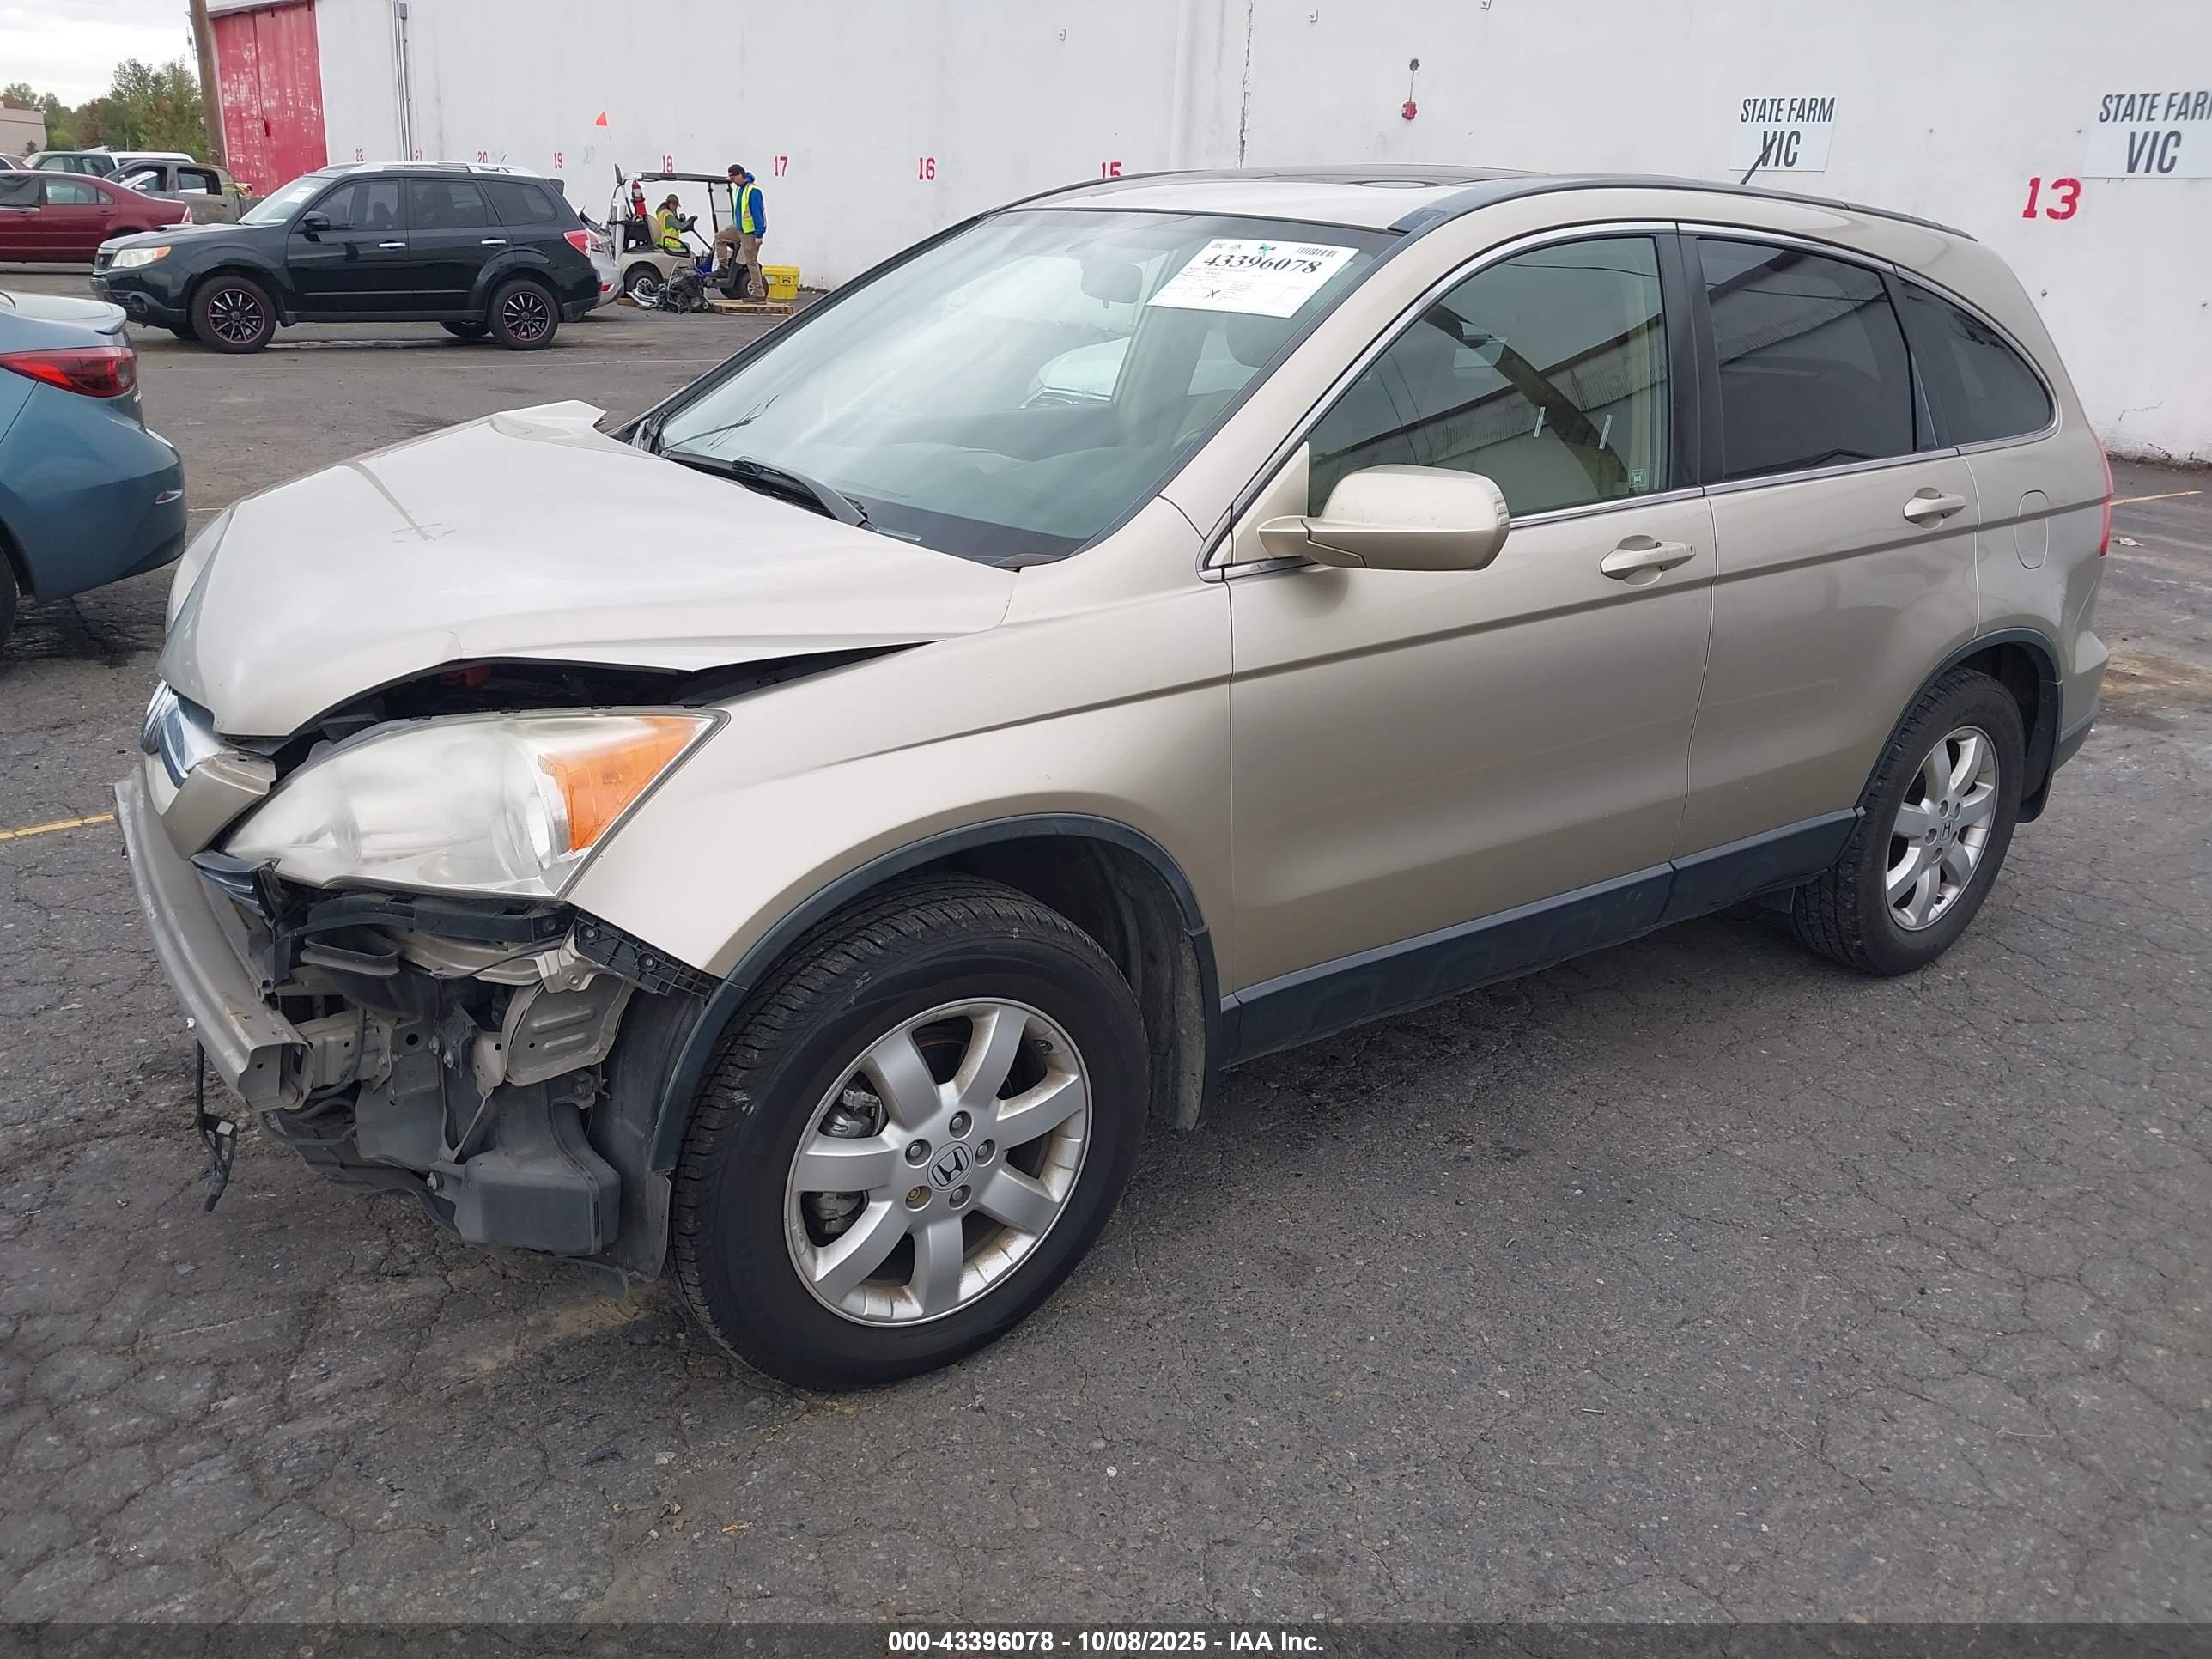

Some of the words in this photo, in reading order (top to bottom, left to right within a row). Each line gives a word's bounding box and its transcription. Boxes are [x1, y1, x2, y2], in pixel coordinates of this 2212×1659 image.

[1741, 98, 1785, 123] STATE
[1787, 97, 1835, 123] FARM
[2099, 93, 2161, 123] STATE
[2163, 90, 2212, 121] FAR
[356, 148, 364, 162] 22
[477, 150, 489, 163] 20
[1762, 131, 1801, 167] VIC
[2127, 131, 2182, 173] VIC
[554, 152, 563, 170] 19
[662, 155, 673, 173] 18
[774, 155, 788, 177] 17
[918, 157, 936, 180] 16
[2022, 177, 2081, 220] 13
[1203, 254, 1322, 274] 43396078
